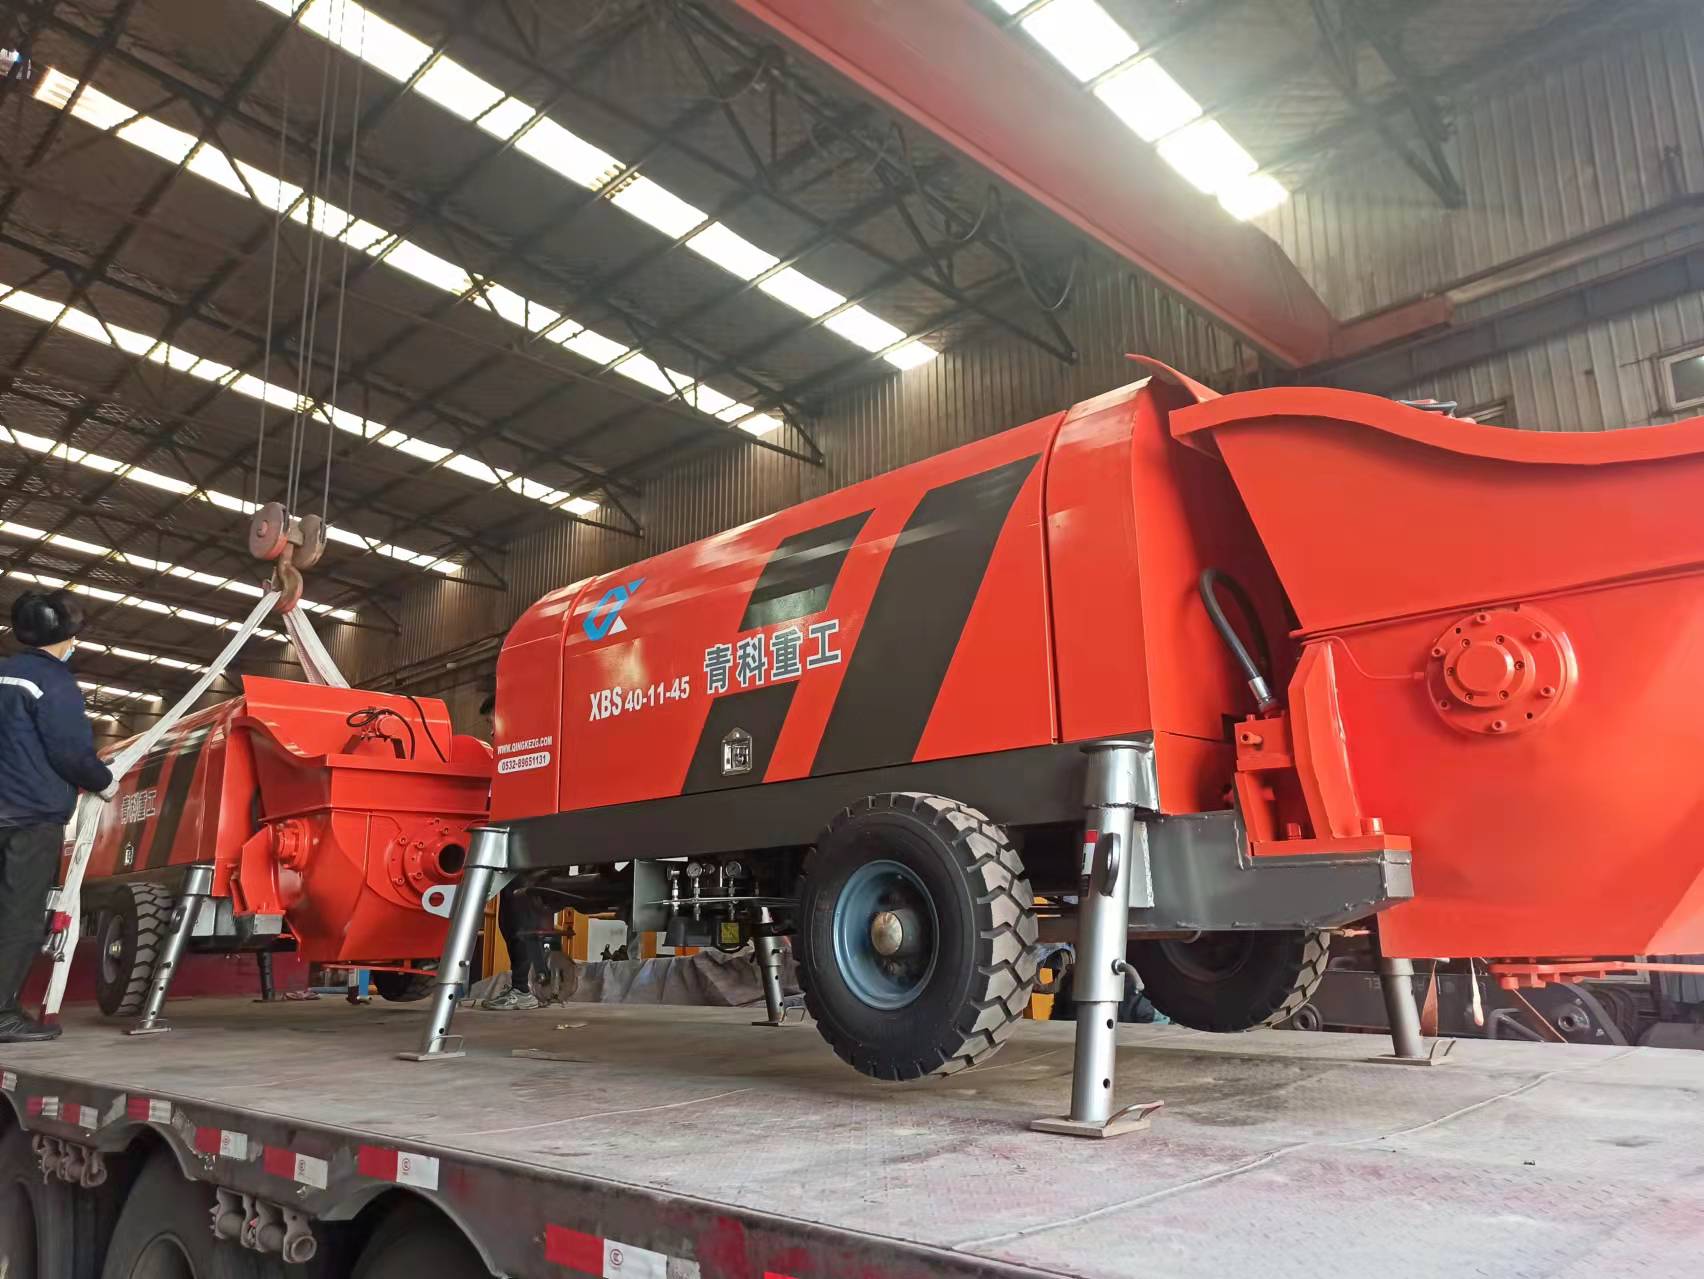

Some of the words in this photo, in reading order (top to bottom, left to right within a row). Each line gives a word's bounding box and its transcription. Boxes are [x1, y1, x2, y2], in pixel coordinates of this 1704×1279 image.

[704, 619, 842, 694] 青科重工
[589, 686, 622, 722] XBS
[624, 675, 690, 712] 40-11-45
[501, 754, 546, 771] 0532-89651131
